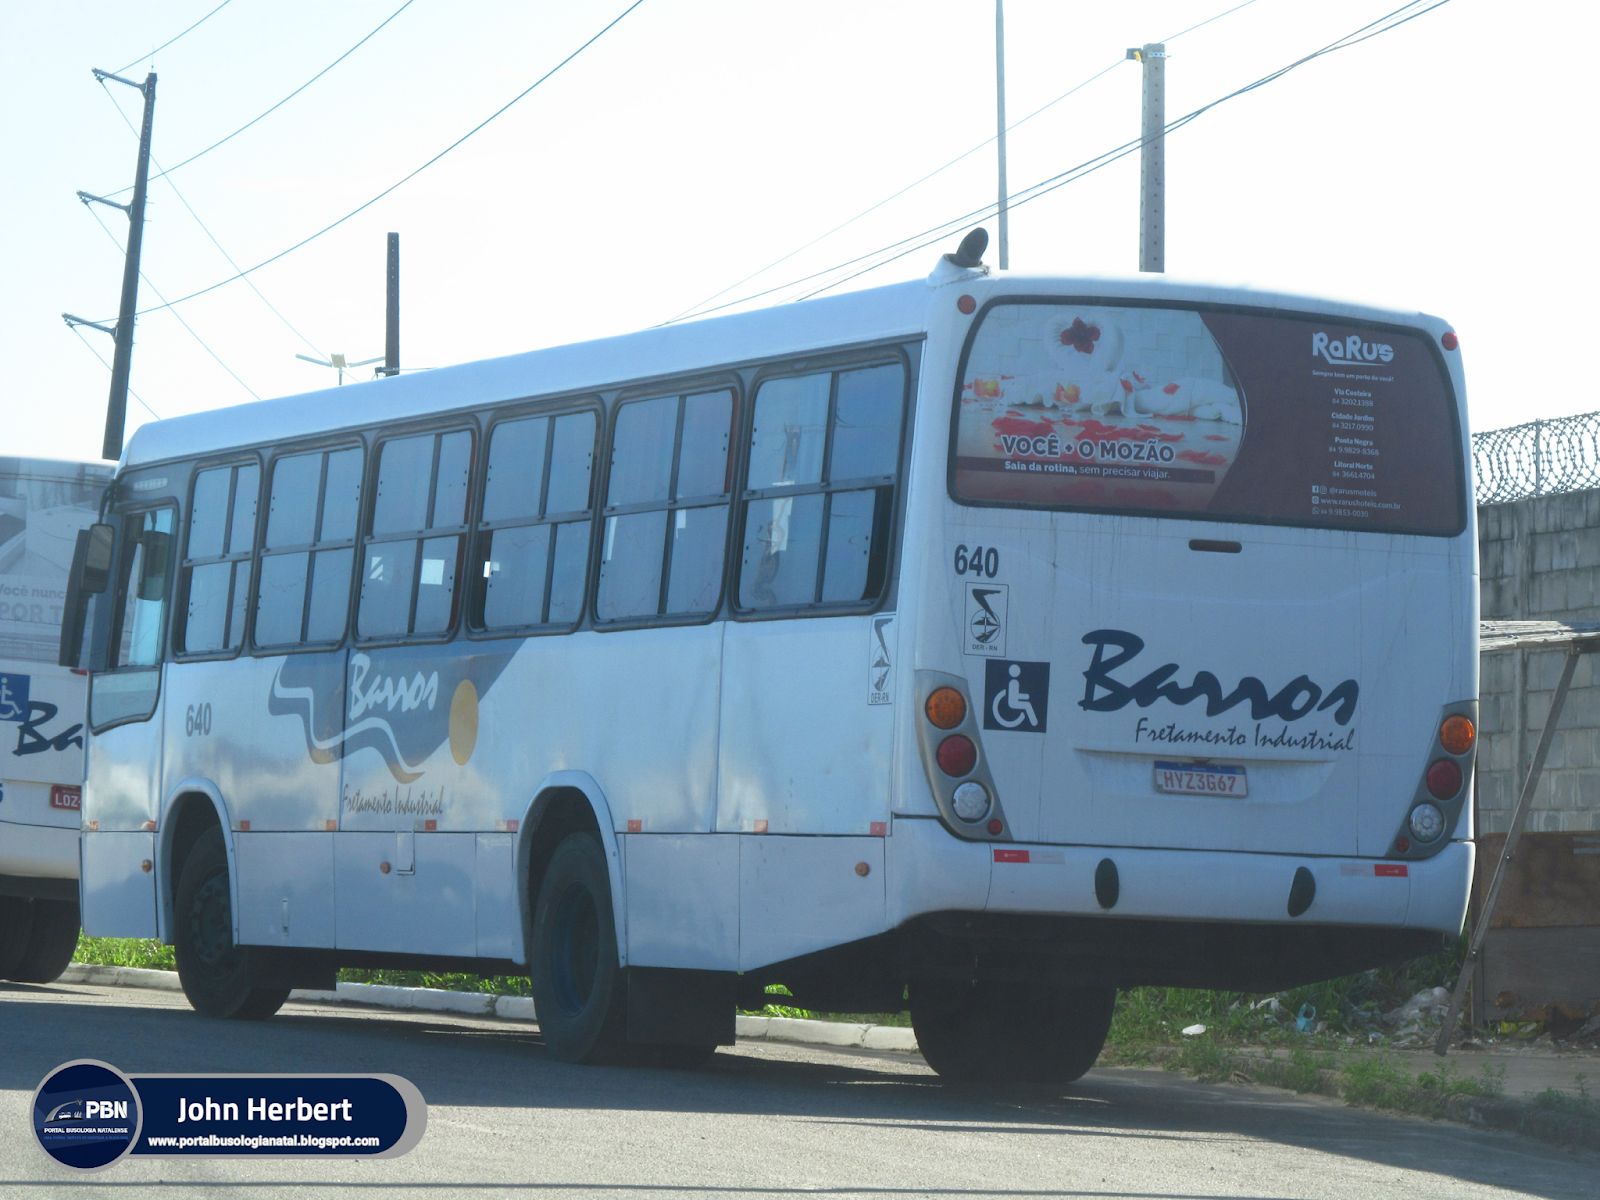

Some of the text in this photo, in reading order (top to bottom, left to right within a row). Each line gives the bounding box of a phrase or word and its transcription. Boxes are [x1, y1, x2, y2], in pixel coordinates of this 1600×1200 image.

[1334, 388, 1371, 397] Via Costeira
[1332, 412, 1353, 420] Cidade
[1341, 423, 1374, 431] 3217.0990
[1002, 434, 1059, 456] VOCÊ
[1078, 440, 1094, 458] O
[1100, 439, 1174, 462] MOZÃO
[1354, 438, 1373, 446] Negra
[1338, 446, 1379, 456] 9.9829-8368
[1004, 461, 1170, 480] Saia da rotina, sem precisar viajar.
[1342, 471, 1375, 479] 3661.4704
[1330, 487, 1377, 497] @rarusmoteis
[1329, 508, 1369, 517] 9.9853-0030
[954, 544, 999, 578] 640
[31, 588, 66, 599] nunc
[1078, 629, 1359, 725] Barros
[350, 653, 438, 720] Barros
[186, 702, 212, 737] 640
[1136, 718, 1355, 751] Fretamento Industrial
[1164, 771, 1236, 792] HYZ3G67
[342, 784, 444, 815] Fretamento Industrial
